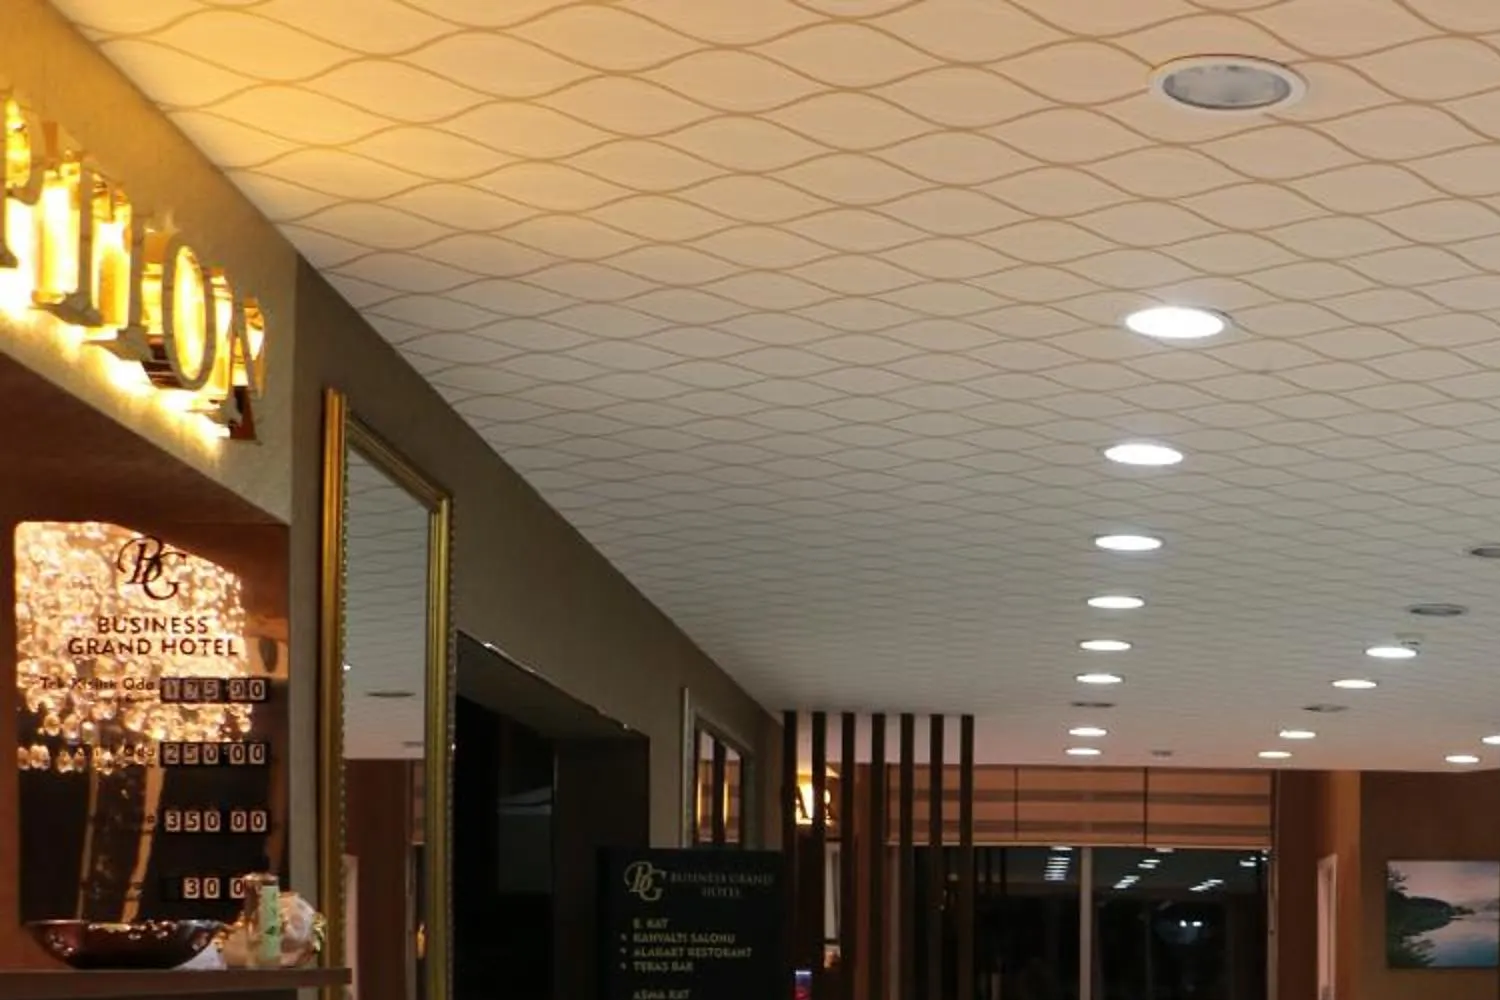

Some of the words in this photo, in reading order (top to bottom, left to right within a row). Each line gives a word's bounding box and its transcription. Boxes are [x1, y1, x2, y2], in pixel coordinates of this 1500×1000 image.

[98, 615, 209, 635] BUSINESS
[67, 637, 151, 656] GRAND
[161, 637, 240, 656] HOTEL
